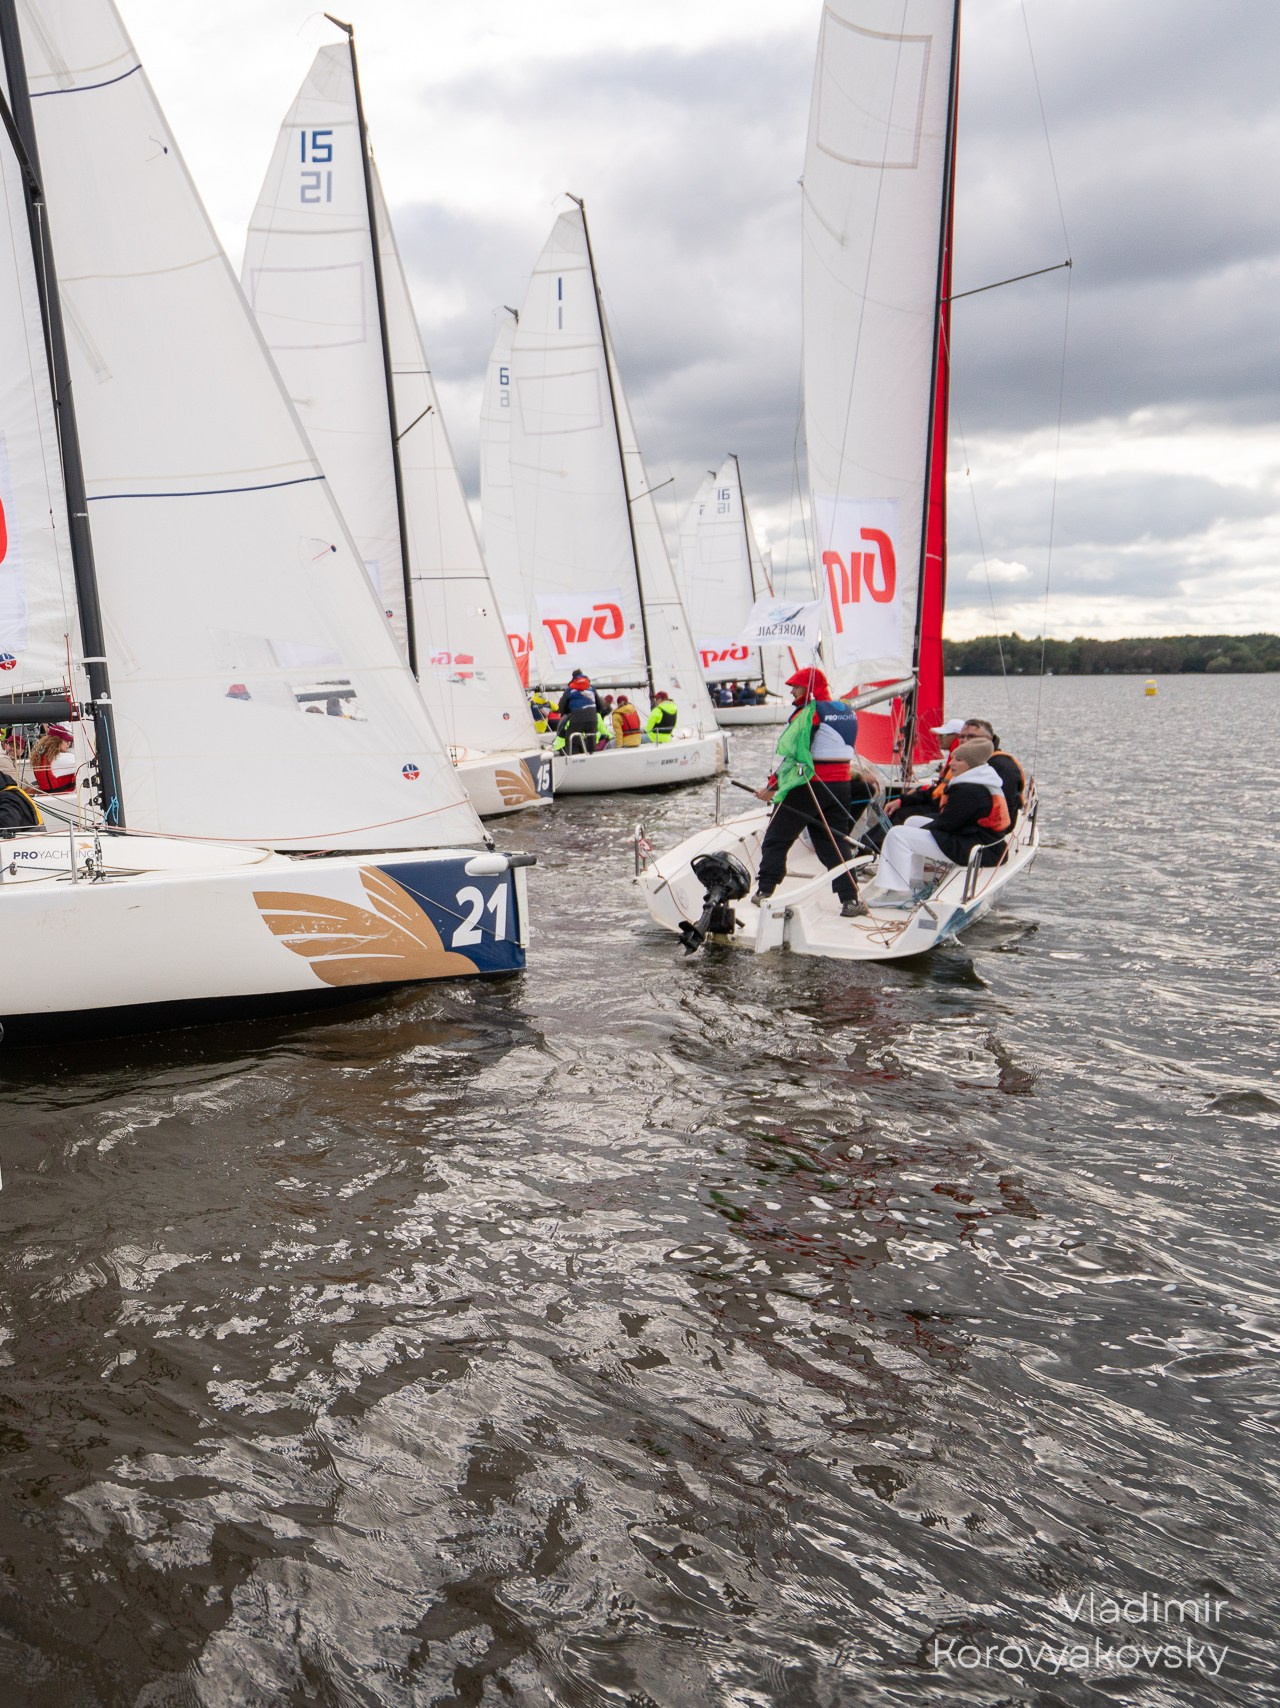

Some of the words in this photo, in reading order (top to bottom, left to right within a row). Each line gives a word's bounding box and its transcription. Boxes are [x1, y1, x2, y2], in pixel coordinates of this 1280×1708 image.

[301, 130, 333, 163] 15
[558, 277, 562, 300] 1
[500, 367, 509, 385] 6
[717, 488, 730, 500] 16
[537, 763, 550, 792] 15
[13, 850, 95, 860] PROYACHING
[451, 883, 508, 948] 21
